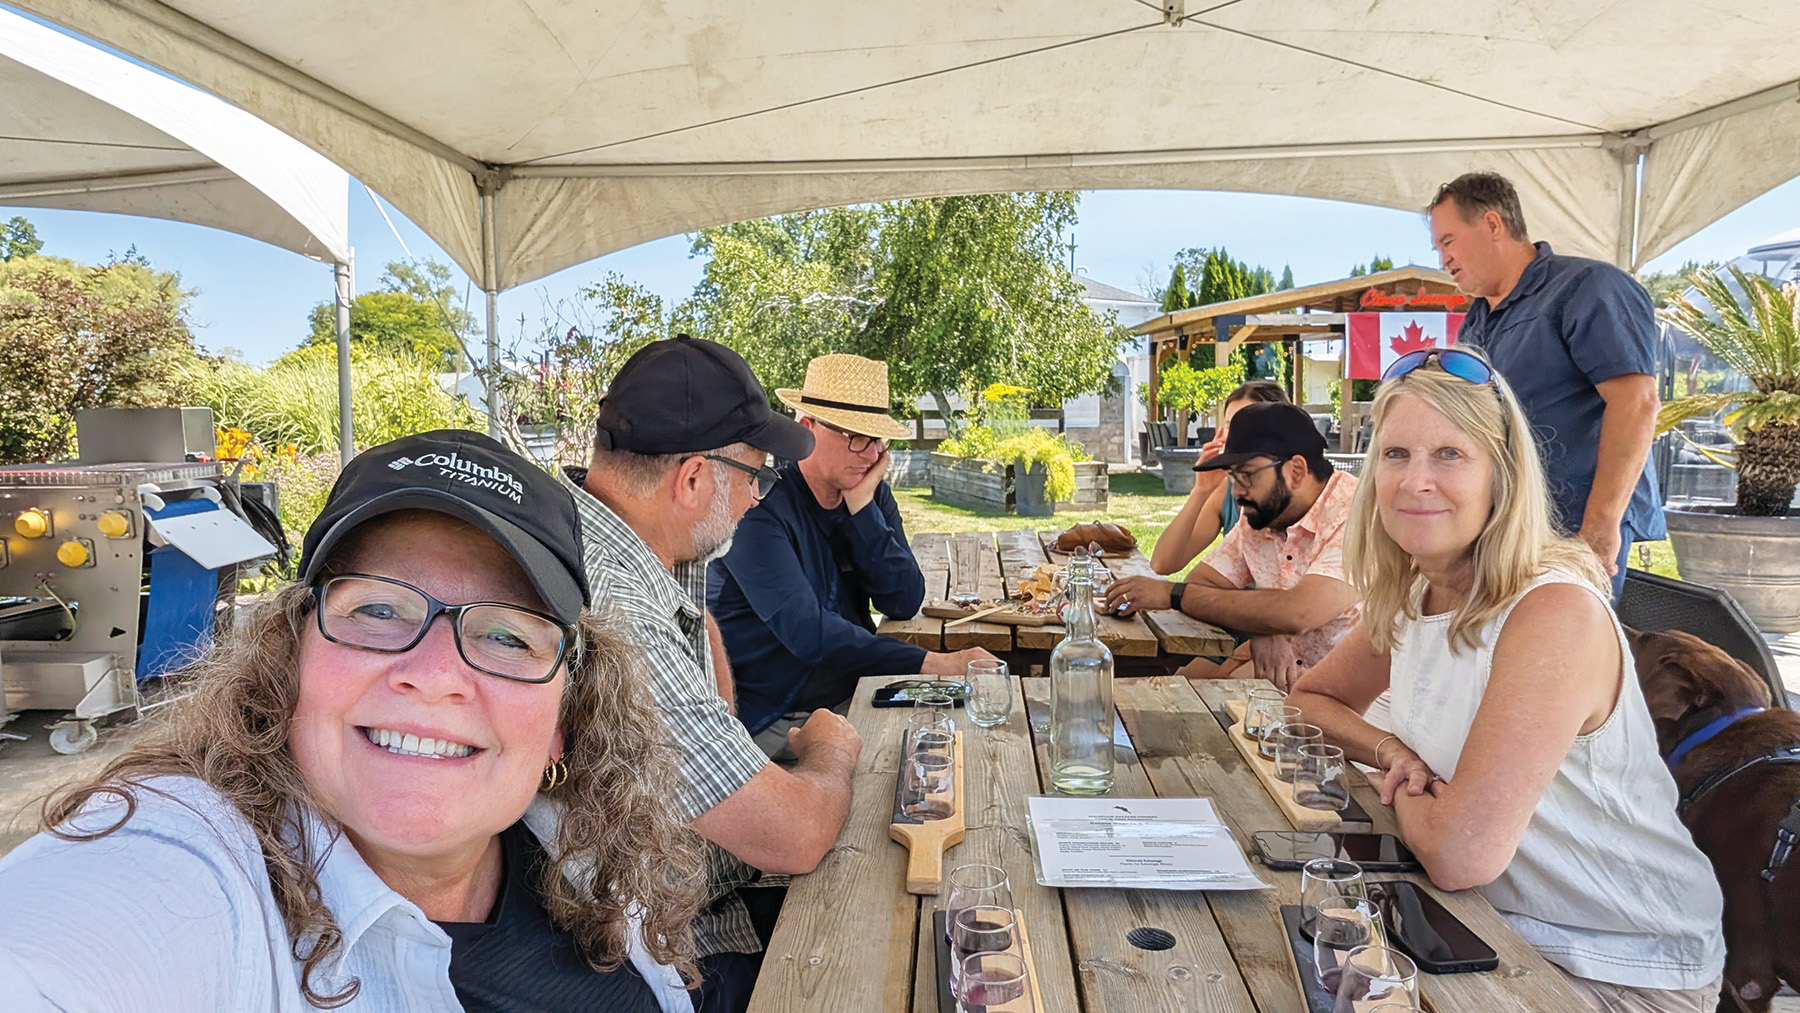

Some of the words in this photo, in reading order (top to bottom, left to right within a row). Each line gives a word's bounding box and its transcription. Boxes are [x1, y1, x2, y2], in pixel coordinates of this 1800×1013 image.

[1410, 287, 1467, 310] Lounge
[414, 452, 524, 495] Columbia
[439, 467, 522, 505] TITANIUM
